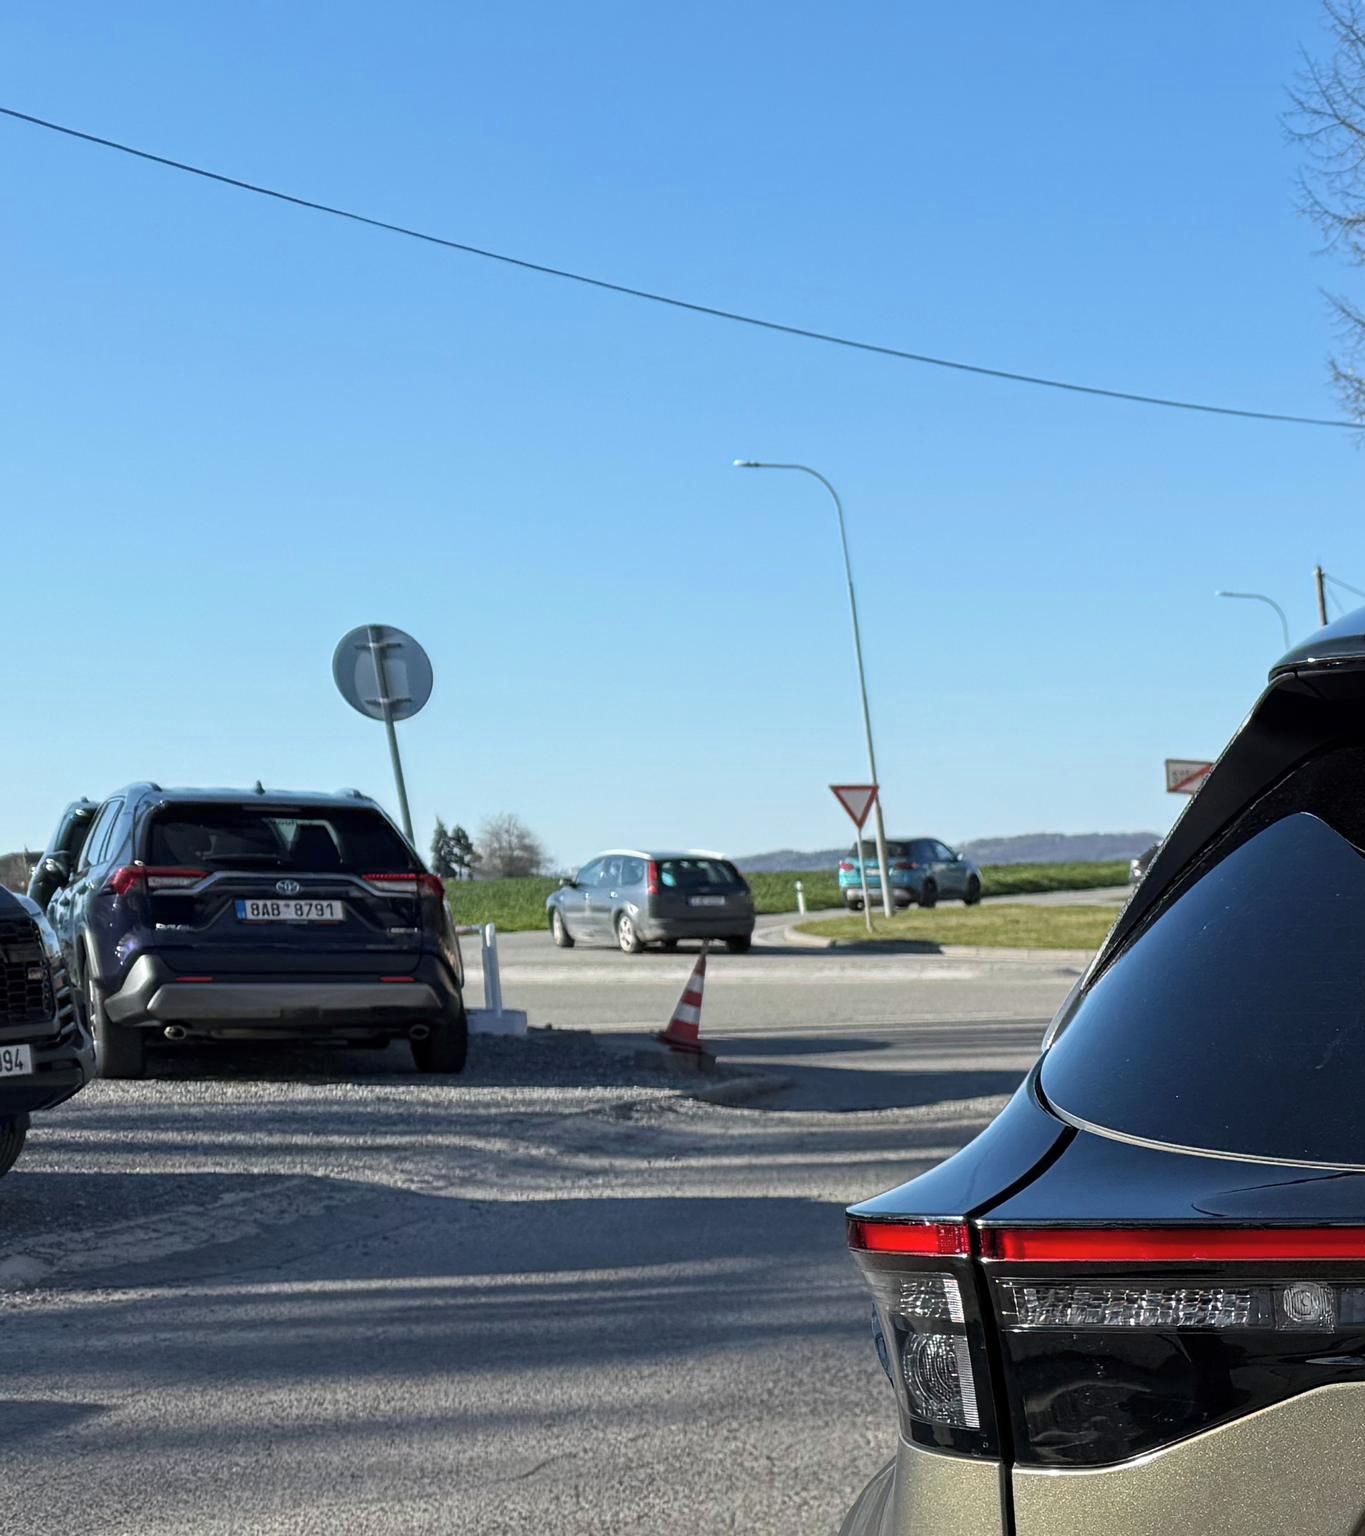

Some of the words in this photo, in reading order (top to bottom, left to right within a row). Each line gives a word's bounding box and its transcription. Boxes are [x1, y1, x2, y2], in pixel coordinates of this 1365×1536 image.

[250, 902, 281, 917] 8AB
[294, 902, 334, 918] 8791
[0, 1048, 23, 1072] 94
